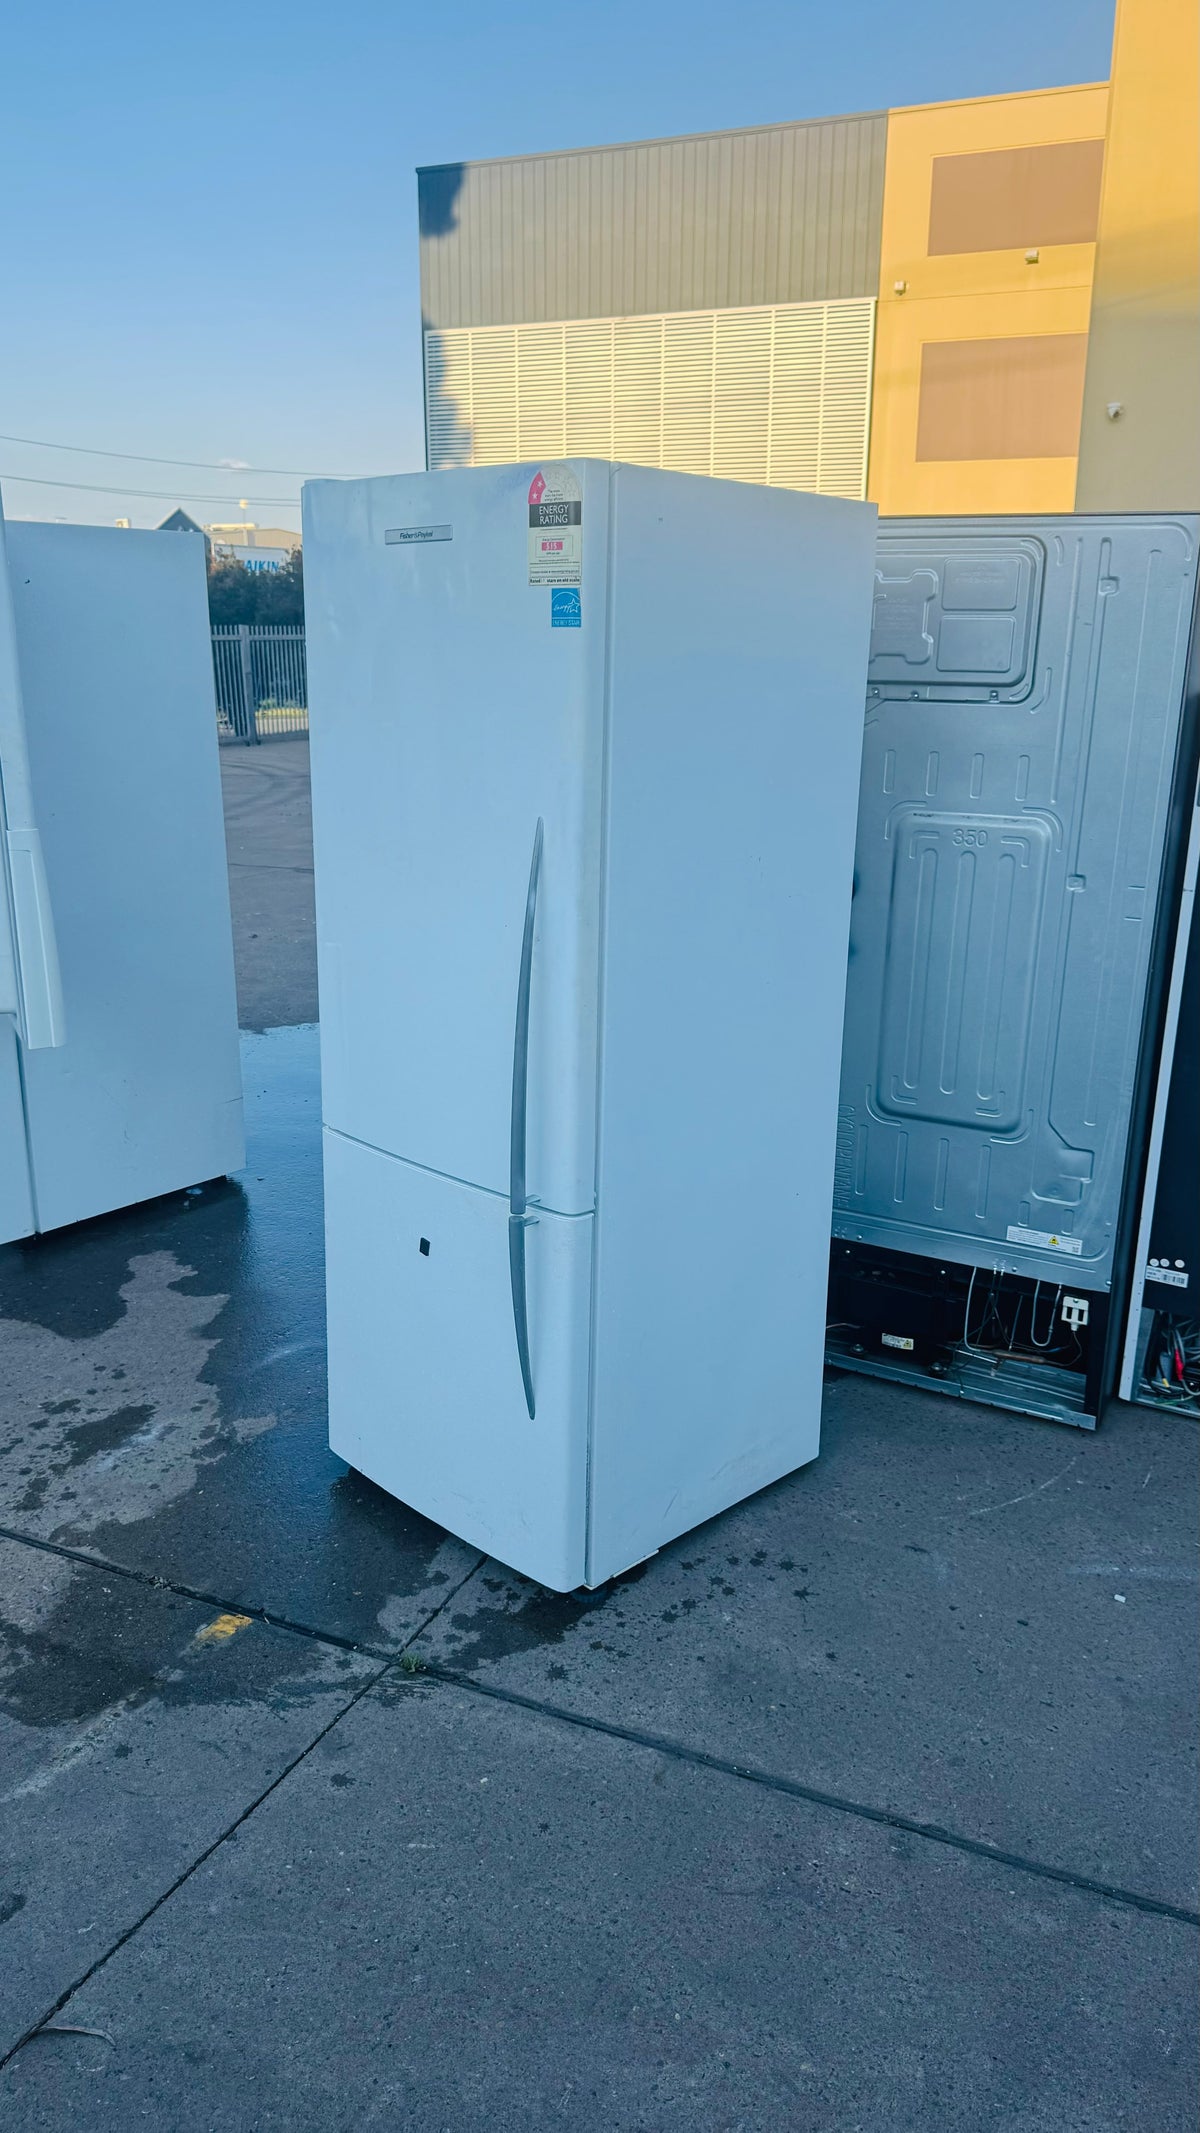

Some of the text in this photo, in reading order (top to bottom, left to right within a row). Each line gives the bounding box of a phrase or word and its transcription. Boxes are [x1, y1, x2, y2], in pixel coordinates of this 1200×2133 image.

[539, 504, 569, 515] ENERGY
[539, 514, 569, 525] RATING
[244, 559, 279, 572] AIKIN
[952, 828, 988, 848] 350
